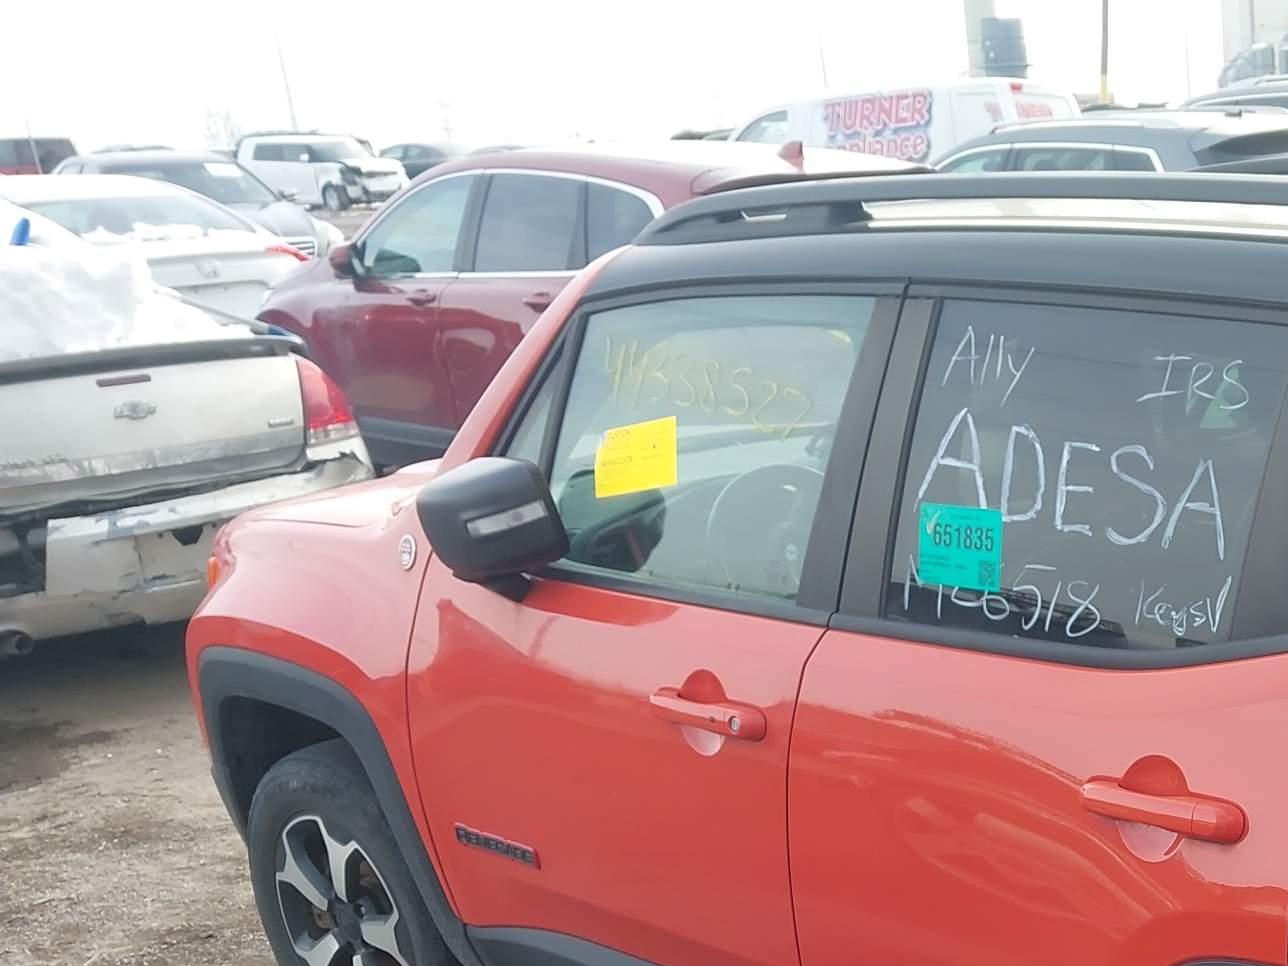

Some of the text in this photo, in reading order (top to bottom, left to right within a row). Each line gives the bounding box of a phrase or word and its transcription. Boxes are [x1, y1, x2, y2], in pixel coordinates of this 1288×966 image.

[824, 91, 931, 135] TURNER
[826, 132, 930, 160] pliance
[606, 337, 814, 440] 44338527
[942, 325, 1249, 415] Ally IRS
[913, 407, 1225, 560] ADESA
[933, 523, 995, 552] 651835
